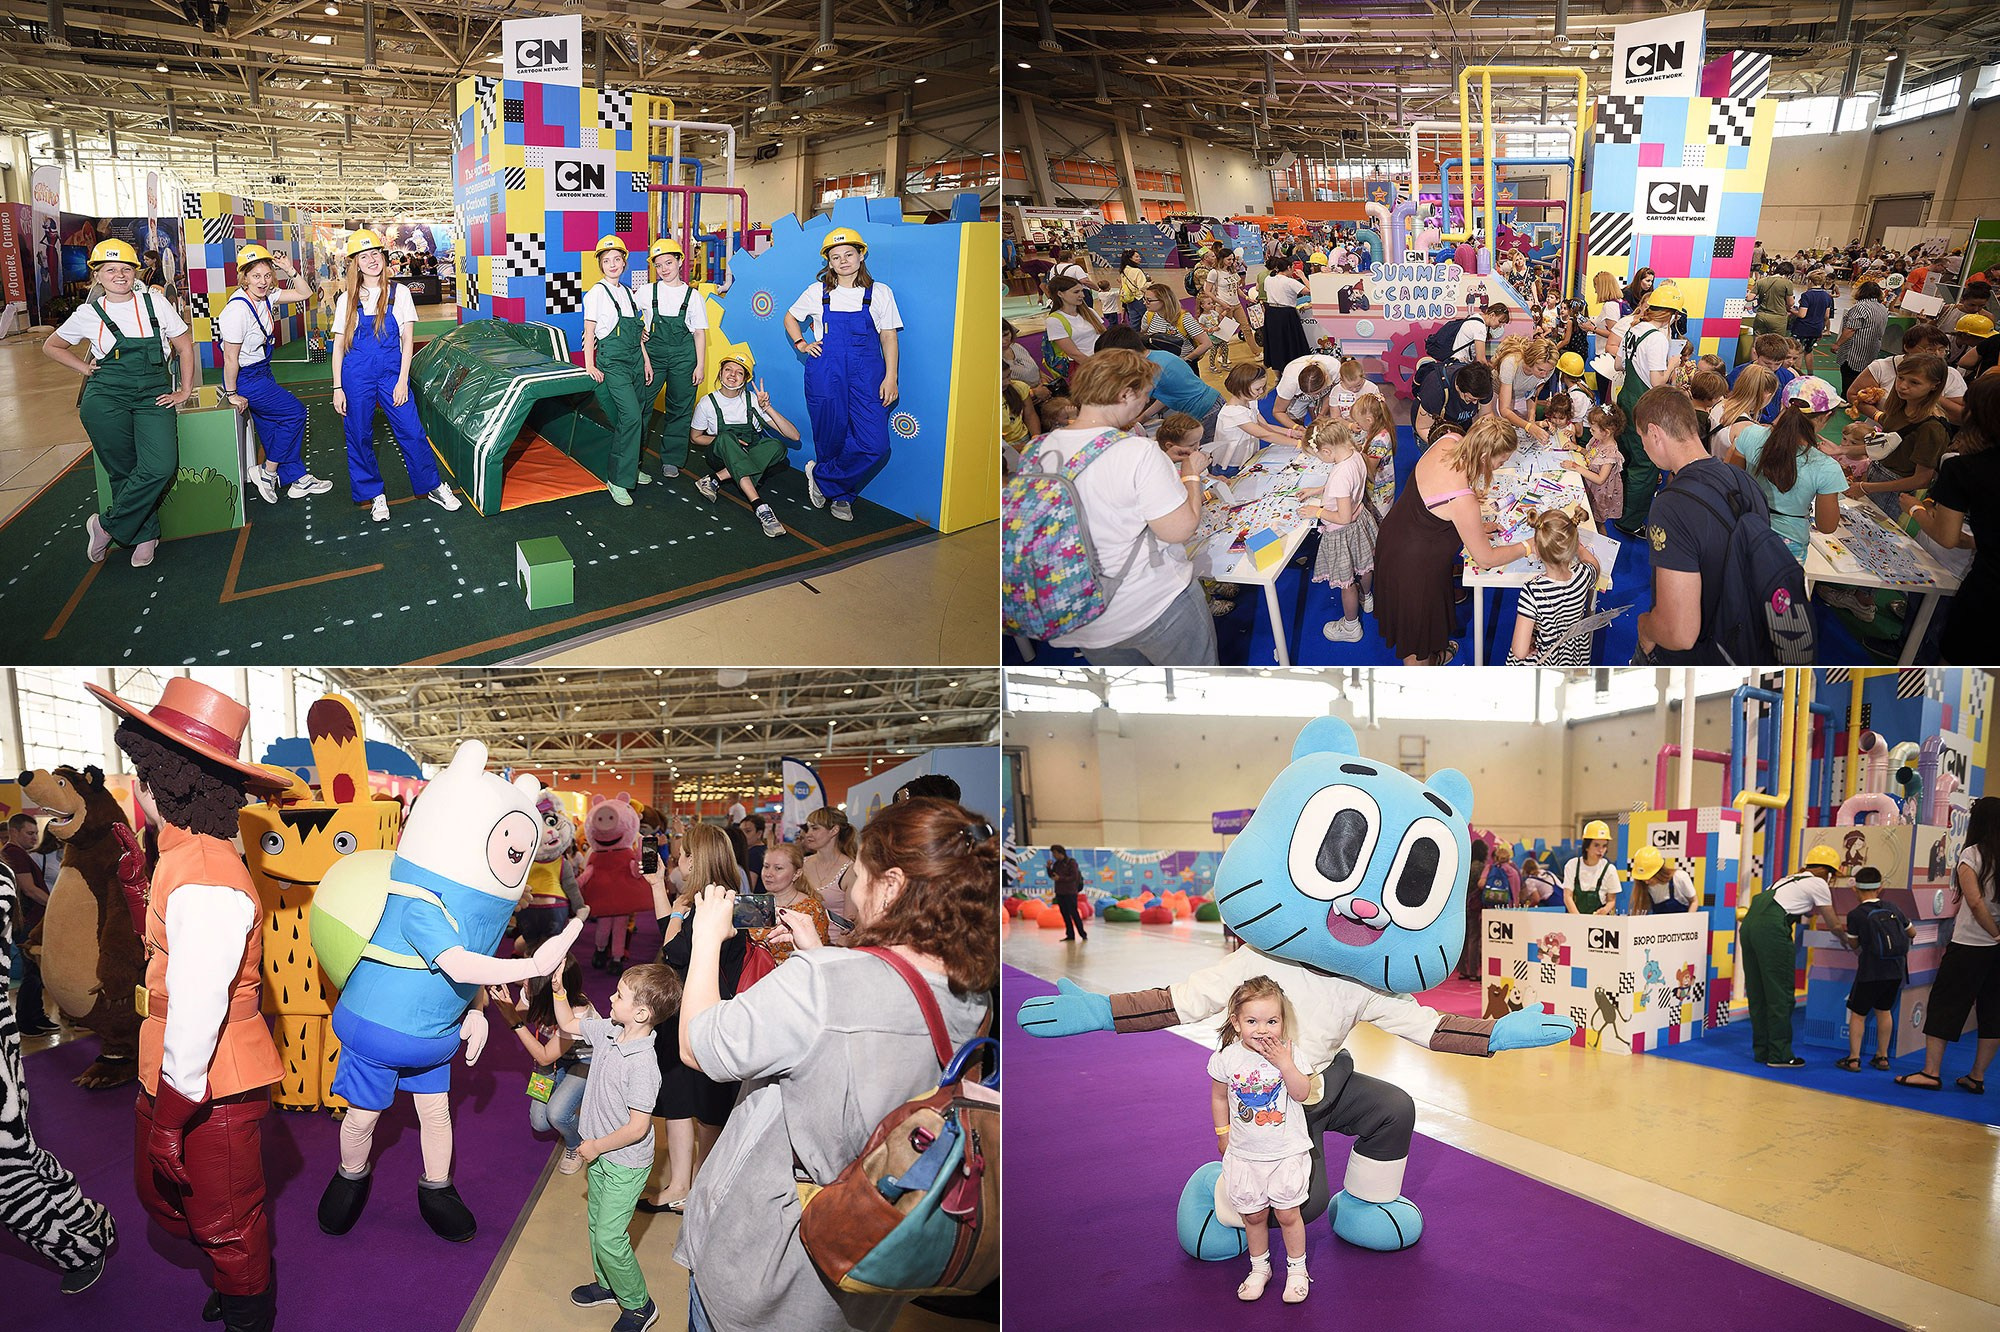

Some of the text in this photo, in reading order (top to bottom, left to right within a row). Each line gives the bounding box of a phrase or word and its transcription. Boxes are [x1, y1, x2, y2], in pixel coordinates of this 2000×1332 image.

[516, 39, 567, 68] CN
[1625, 41, 1684, 78] CN
[1625, 72, 1682, 84] CARTOON NETWORK
[555, 161, 604, 191] CN
[466, 196, 488, 211] Cartoon
[1646, 182, 1708, 214] CN
[1406, 251, 1424, 261] CN
[1371, 263, 1461, 282] SUMMER
[1385, 286, 1443, 301] CAMP
[1384, 303, 1456, 319] ISLAND
[1652, 830, 1680, 847] CN
[1488, 921, 1513, 940] CN
[1588, 928, 1619, 949] CN
[1633, 931, 1699, 946] БЮРО ПРОПУСКОВ
